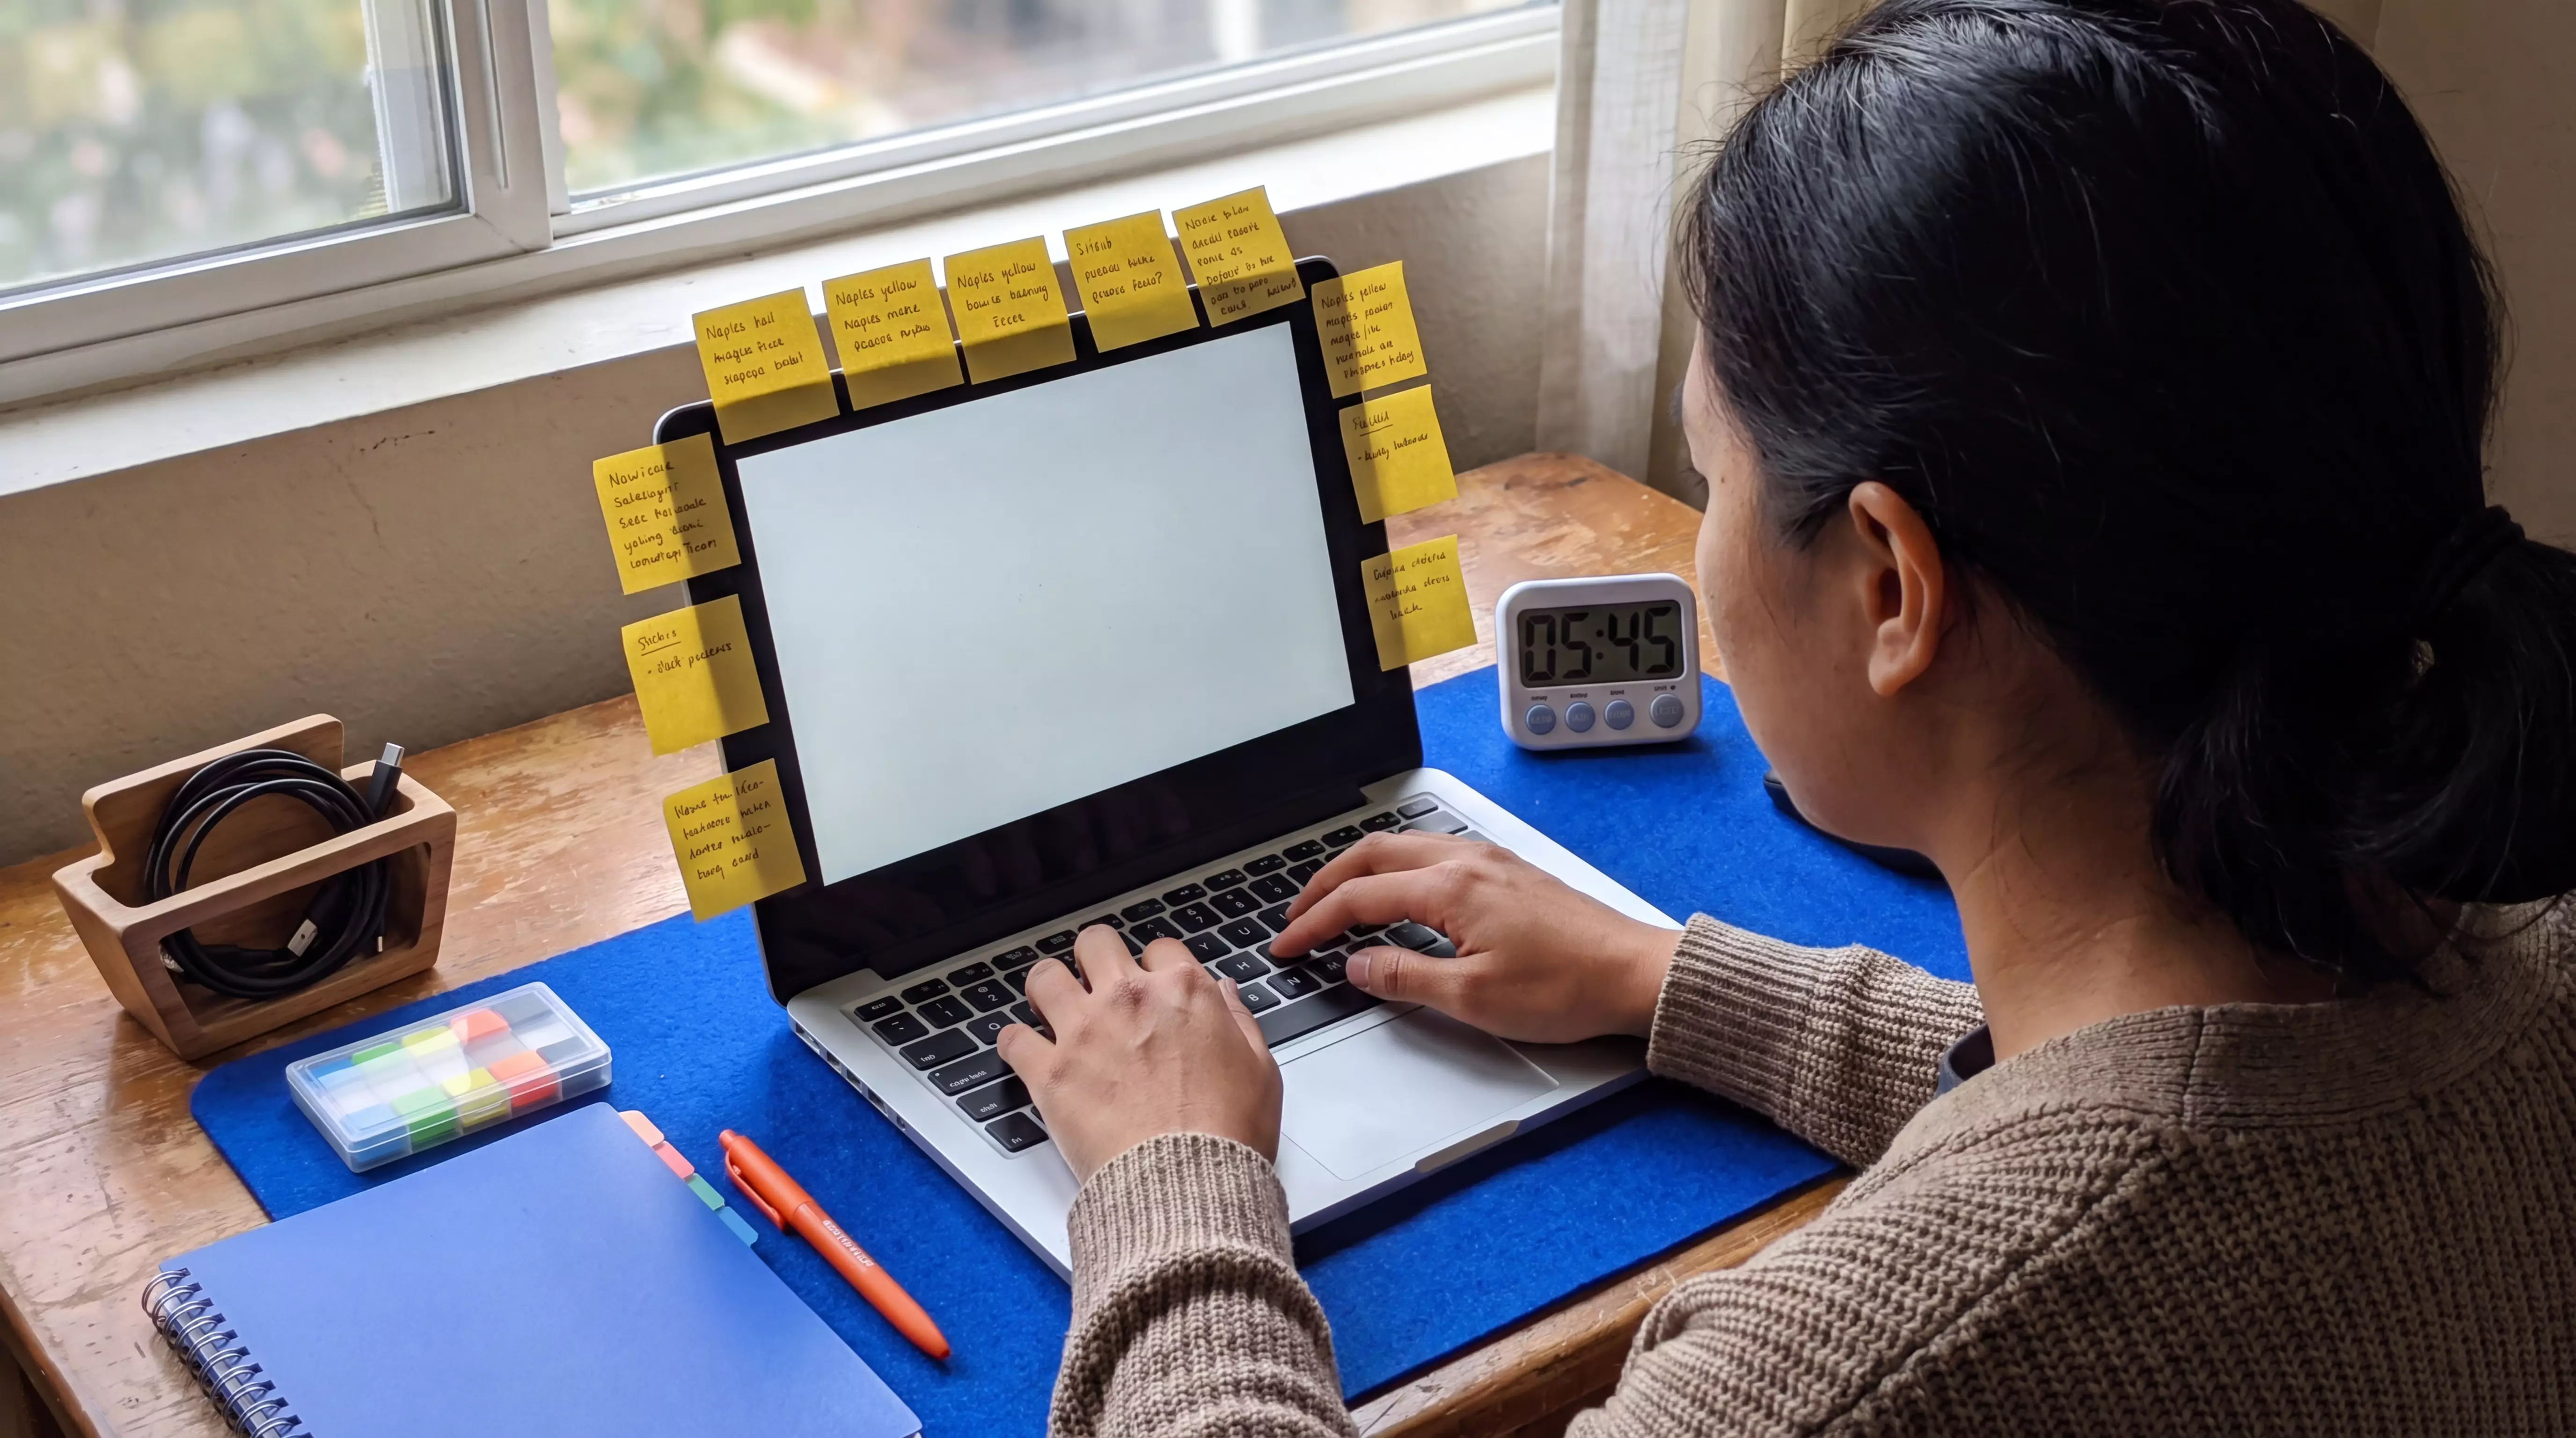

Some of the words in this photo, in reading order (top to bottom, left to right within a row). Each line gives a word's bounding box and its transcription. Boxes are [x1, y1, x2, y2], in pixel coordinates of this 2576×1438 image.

[958, 272, 994, 289] Naples
[1002, 263, 1036, 284] yellow
[836, 288, 874, 306] Naples
[881, 280, 916, 302] yellow
[1322, 292, 1354, 309] Naples
[706, 322, 746, 340] Naples
[844, 315, 881, 332] Naples
[1525, 606, 1675, 682] 05:45
[1237, 961, 1250, 970] H
